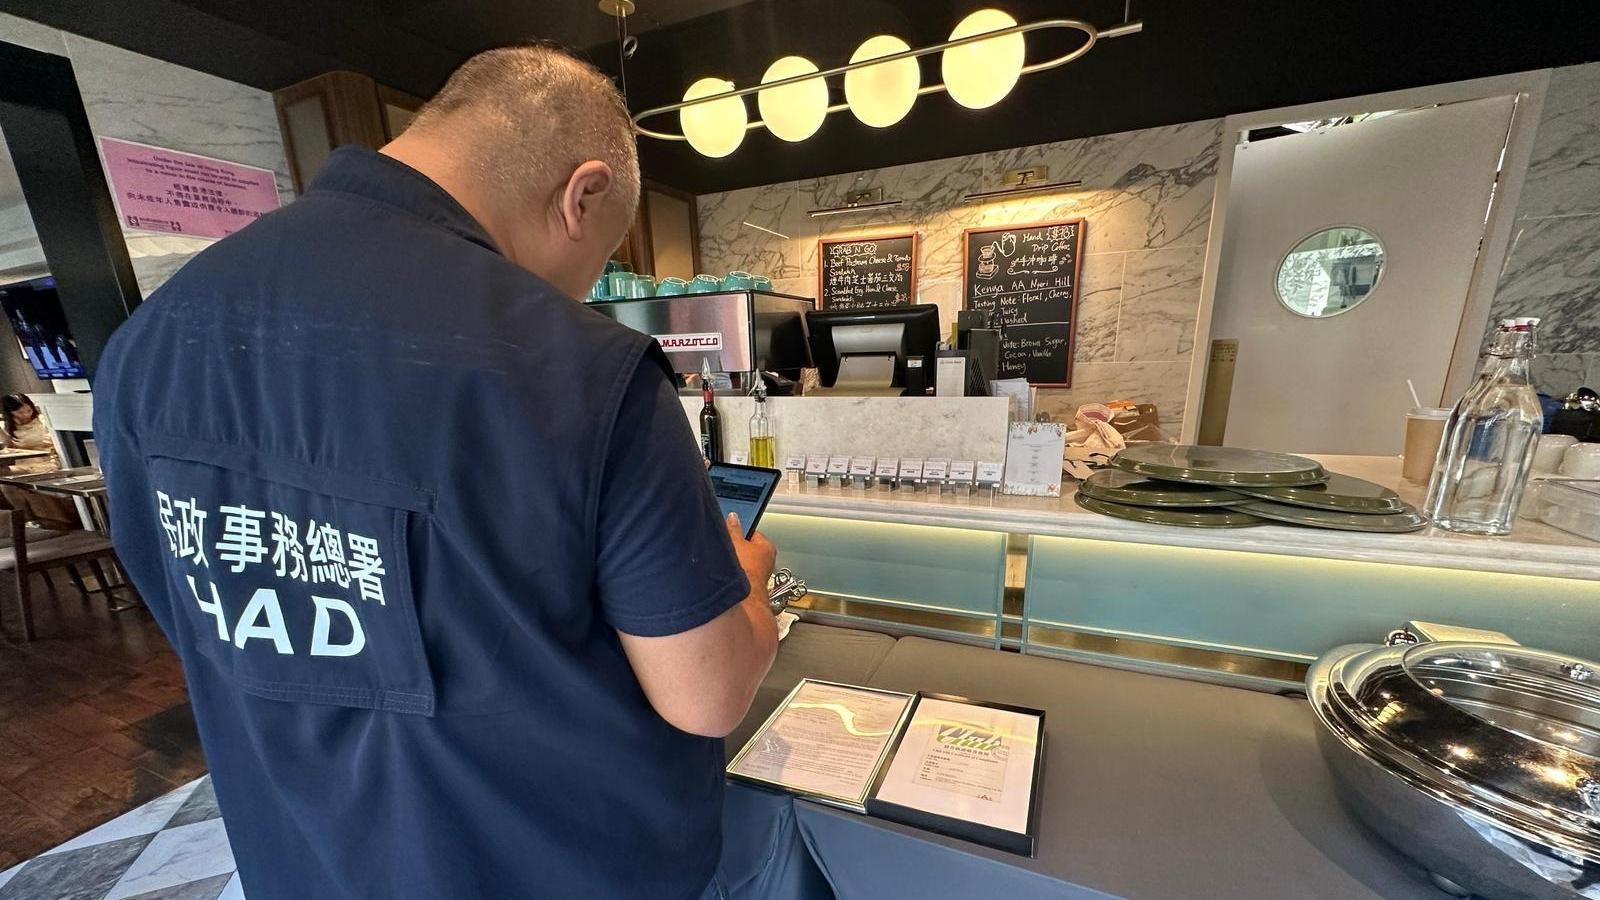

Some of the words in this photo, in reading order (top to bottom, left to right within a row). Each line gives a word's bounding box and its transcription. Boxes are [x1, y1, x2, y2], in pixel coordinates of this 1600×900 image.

[1022, 232, 1044, 243] Hand
[833, 244, 852, 255] GRAB
[864, 244, 875, 254] GO
[1031, 242, 1049, 253] Drip
[830, 257, 844, 268] Beef
[974, 283, 1004, 298] Kenya
[1011, 280, 1026, 291] AA
[1054, 275, 1070, 287] Hill
[1002, 361, 1027, 374] Honey
[186, 575, 366, 657] HAD
